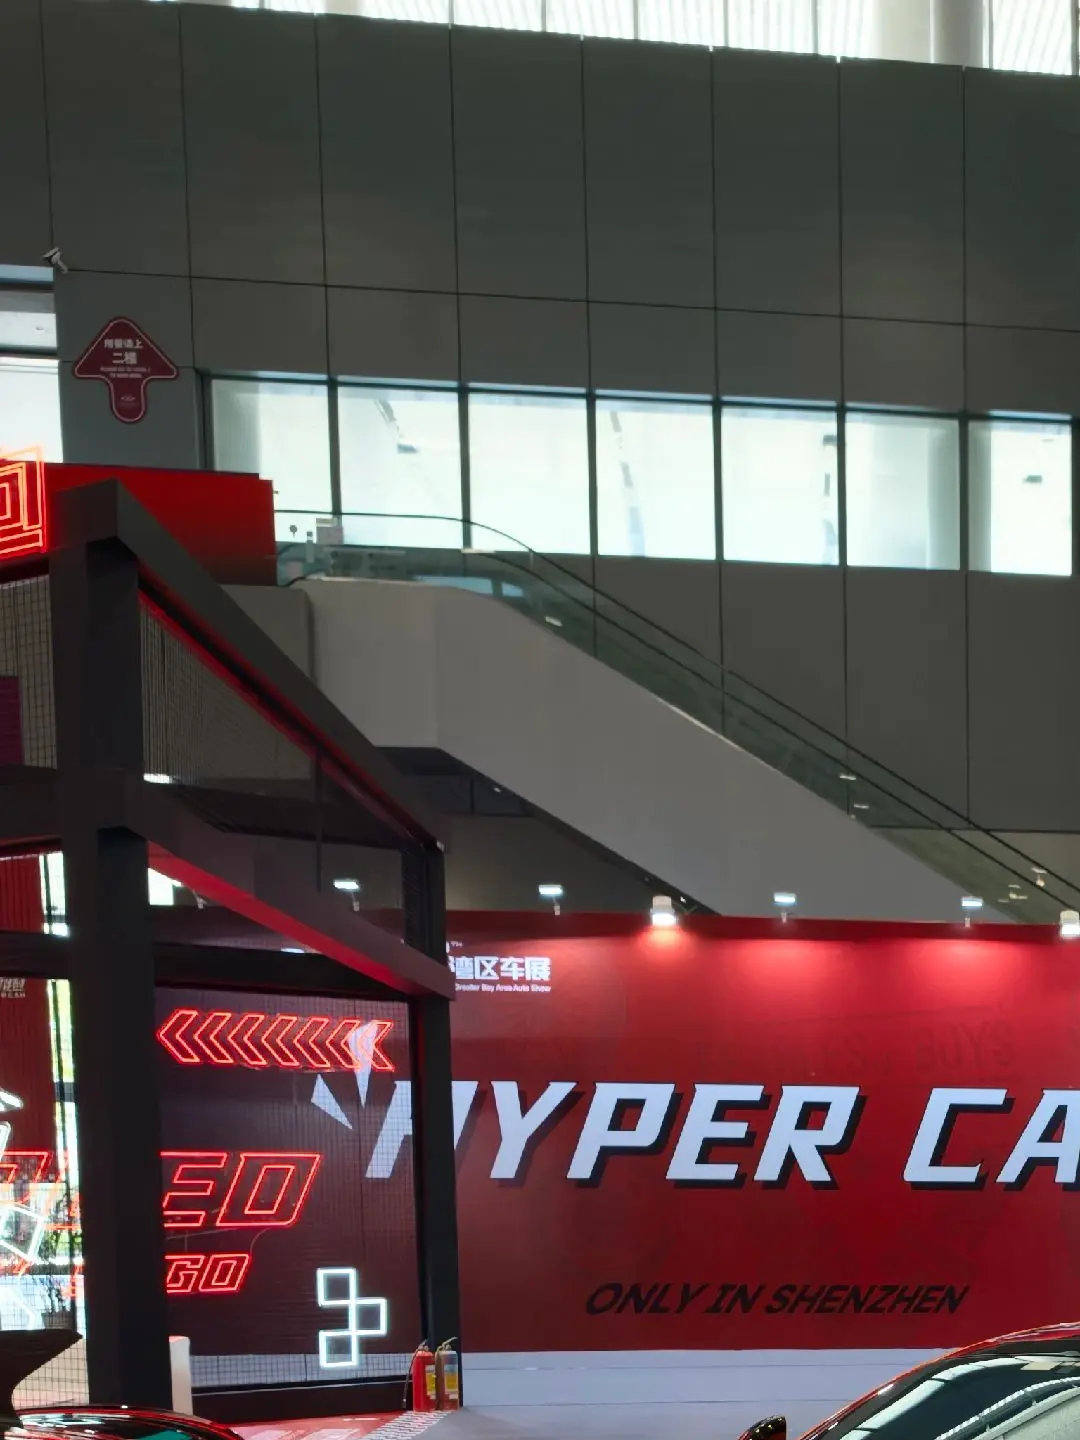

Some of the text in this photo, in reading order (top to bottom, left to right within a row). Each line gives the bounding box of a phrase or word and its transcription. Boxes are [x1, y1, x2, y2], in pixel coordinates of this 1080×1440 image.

[586, 1282, 970, 1316] ONLY IN SHENZHEN
